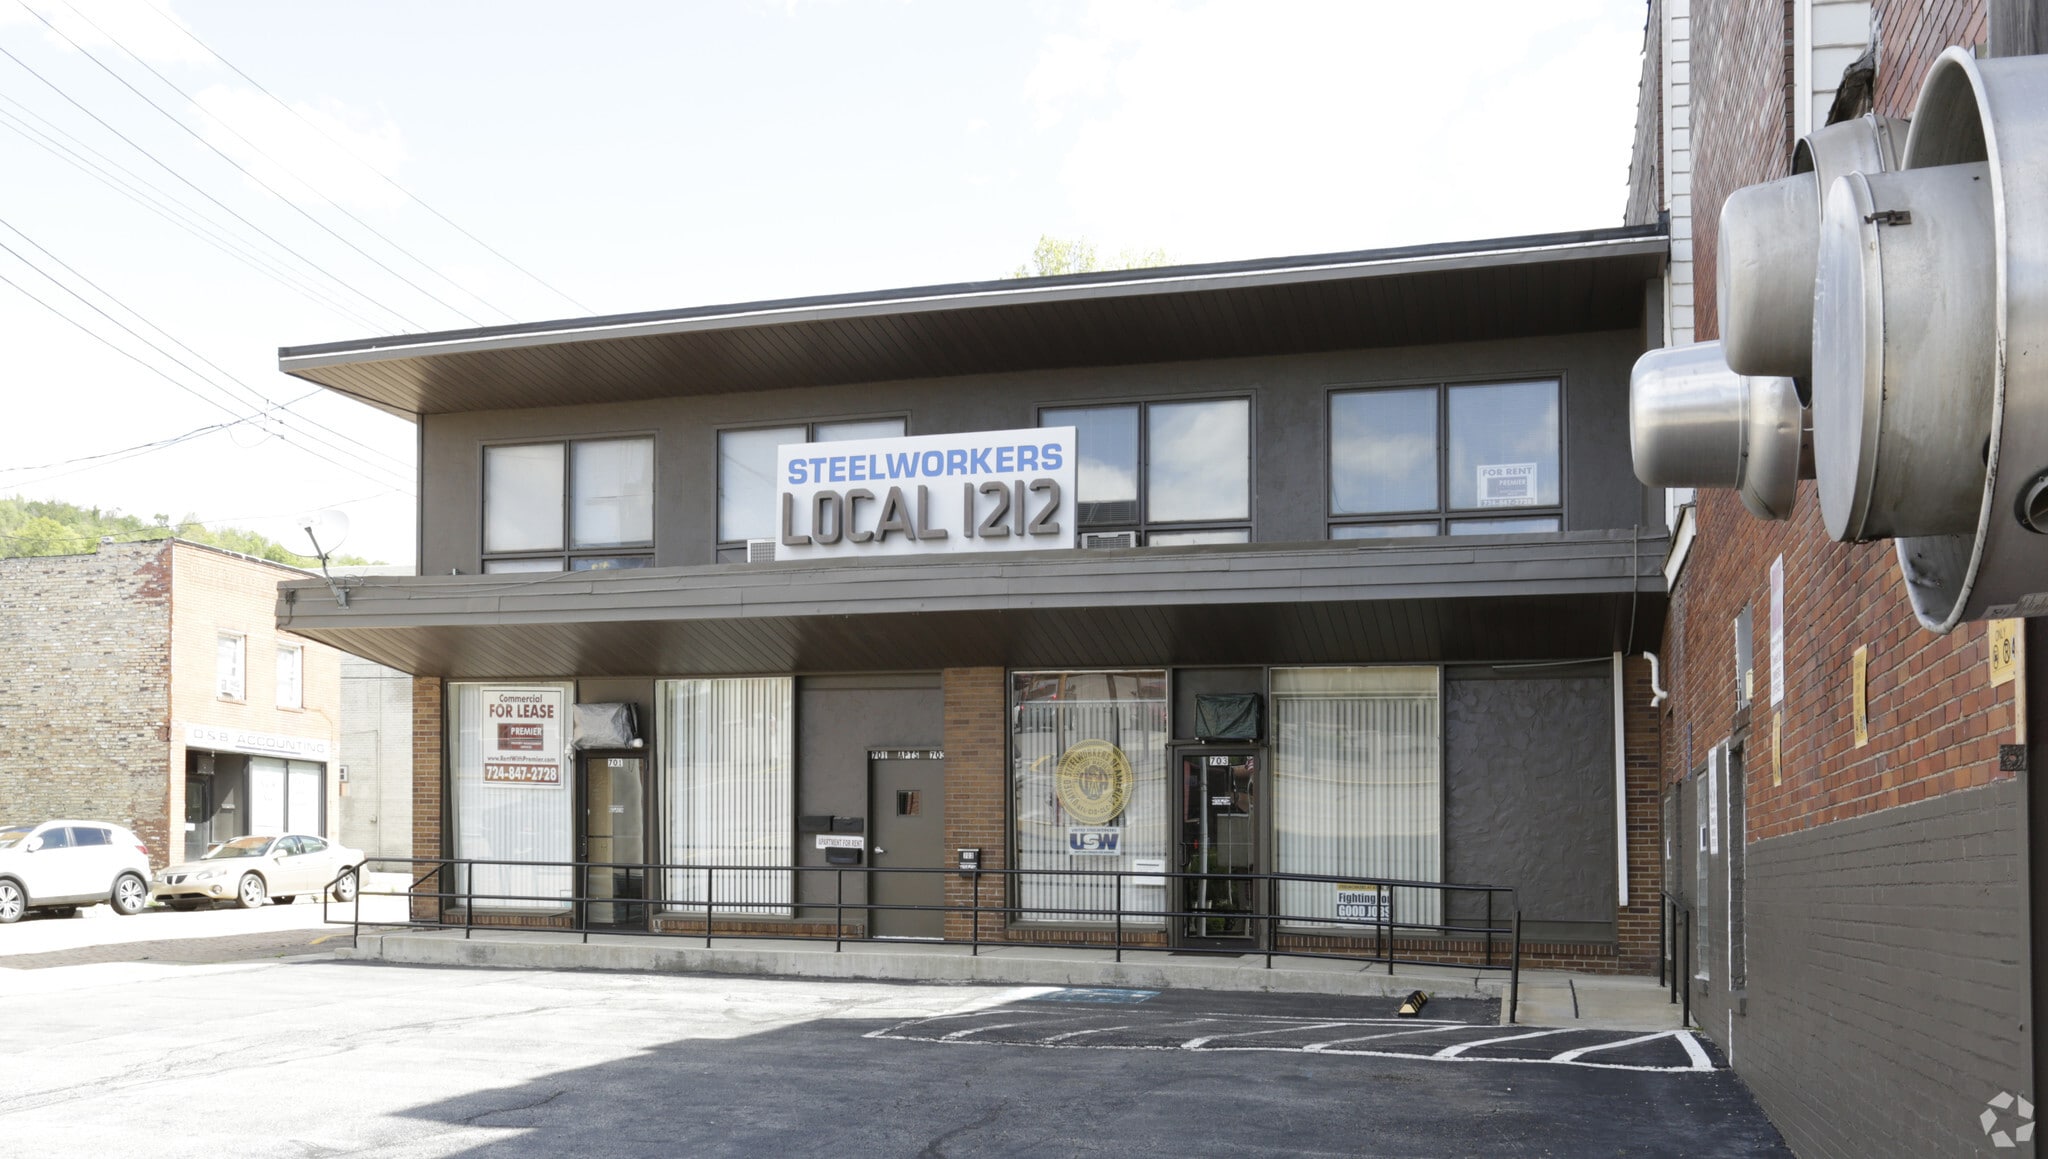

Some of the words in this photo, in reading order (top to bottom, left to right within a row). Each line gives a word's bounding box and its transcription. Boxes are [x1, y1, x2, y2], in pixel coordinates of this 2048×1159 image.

[788, 443, 1063, 484] STEELWORKERS
[1482, 469, 1502, 477] FOR
[1506, 467, 1532, 475] RENT
[782, 484, 948, 546] LOCAL
[964, 478, 1061, 538] 1212
[499, 694, 543, 703] Commercial
[489, 704, 513, 718] FOR
[517, 704, 554, 719] LEASE
[511, 727, 542, 736] PREMIER
[237, 734, 325, 753] ACCOUNTING
[871, 751, 888, 759] 701
[1210, 756, 1228, 765] 703
[608, 759, 623, 767] 701
[486, 765, 557, 781] 724-847-2728
[1070, 833, 1119, 850] USW
[1338, 892, 1376, 904] Fighting
[1338, 905, 1366, 917] GOOD
